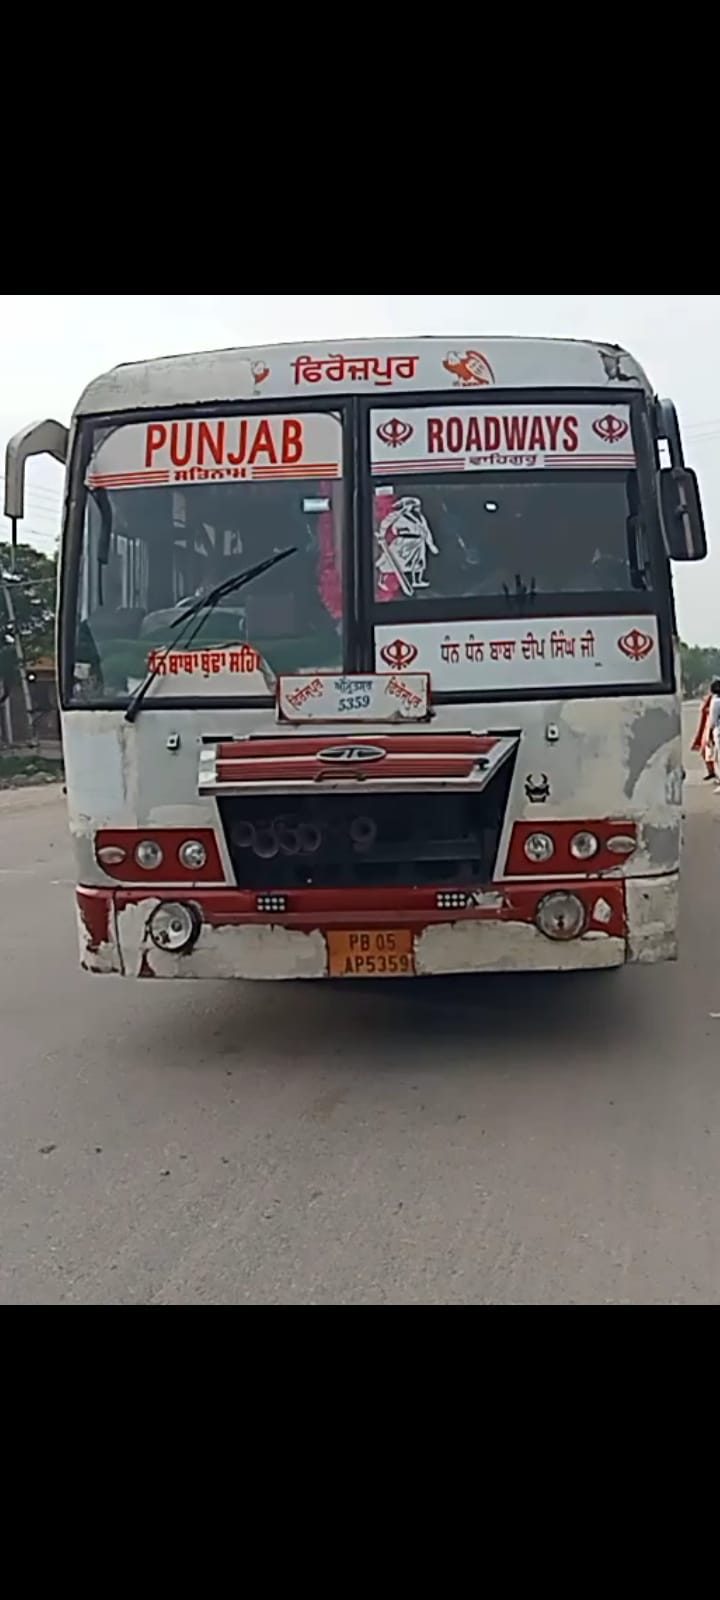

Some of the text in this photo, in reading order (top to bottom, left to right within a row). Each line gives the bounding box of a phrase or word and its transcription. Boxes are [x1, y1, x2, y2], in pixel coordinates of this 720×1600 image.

[290, 353, 419, 386] ਫਿਰੋਜ਼ਪੁਰ
[145, 419, 304, 467] PUNJAB
[427, 415, 579, 453] ROADWAYS
[440, 629, 595, 664] ਧੰਨ ਧੰਨ ਬਾਬਾ ਦੀਪ ਸਿੰਘ ਜੀ
[169, 654, 199, 675] ਬਾਬਾ
[338, 695, 371, 712] 5359
[349, 933, 396, 952] PB 05
[345, 954, 409, 973] AP5359
